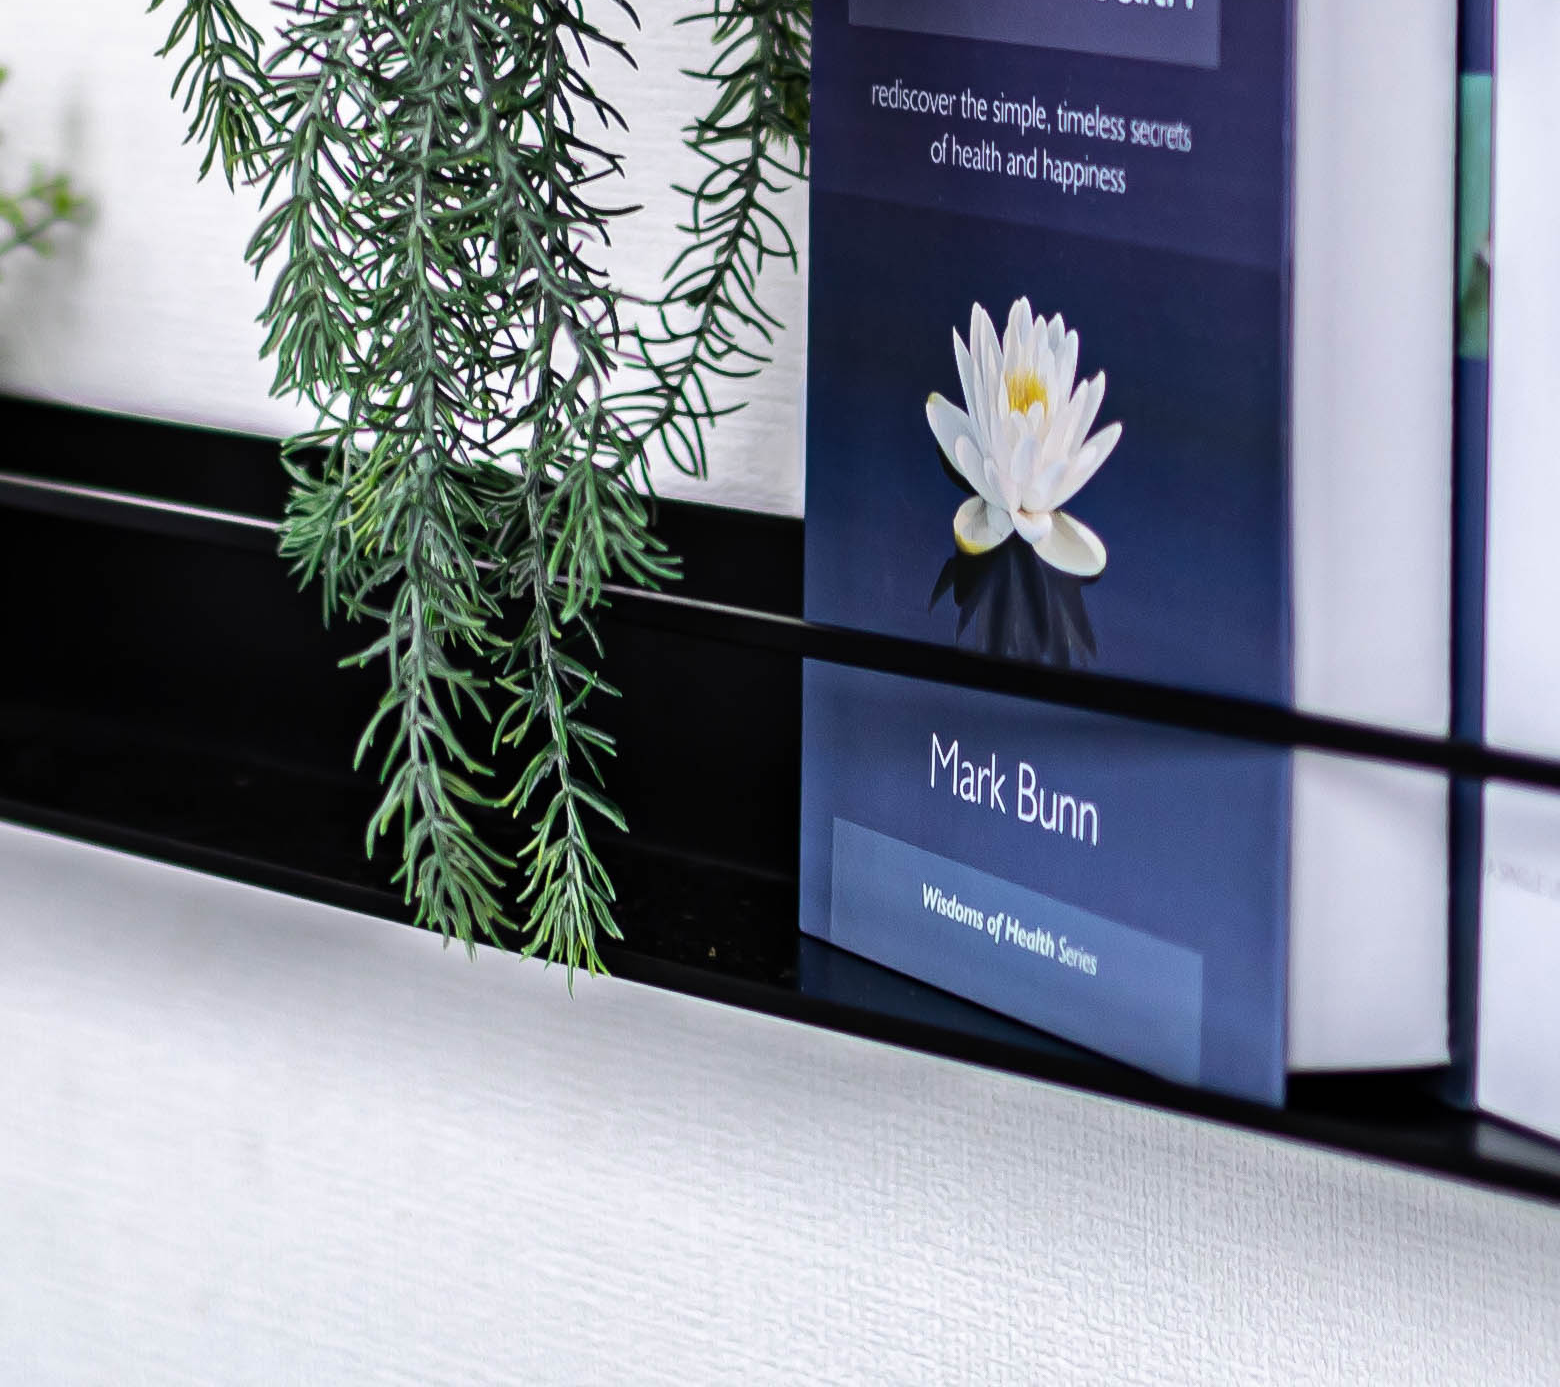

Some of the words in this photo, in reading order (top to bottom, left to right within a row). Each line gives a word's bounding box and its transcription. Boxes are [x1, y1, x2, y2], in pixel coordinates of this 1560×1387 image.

[871, 78, 956, 115] rediscover
[961, 88, 987, 121] the
[992, 92, 1051, 135] simple,
[1057, 100, 1125, 142] timeless
[1130, 118, 1191, 152] secrets
[930, 132, 950, 164] of
[952, 135, 1001, 173] health
[1006, 147, 1037, 179] and
[1043, 148, 1126, 195] happiness
[930, 732, 1006, 814] Mark
[1018, 762, 1098, 846] Bunn
[922, 882, 984, 930] Wisdoms
[986, 912, 1005, 944] of
[1004, 915, 1055, 959] Health
[1058, 936, 1098, 976] Series
